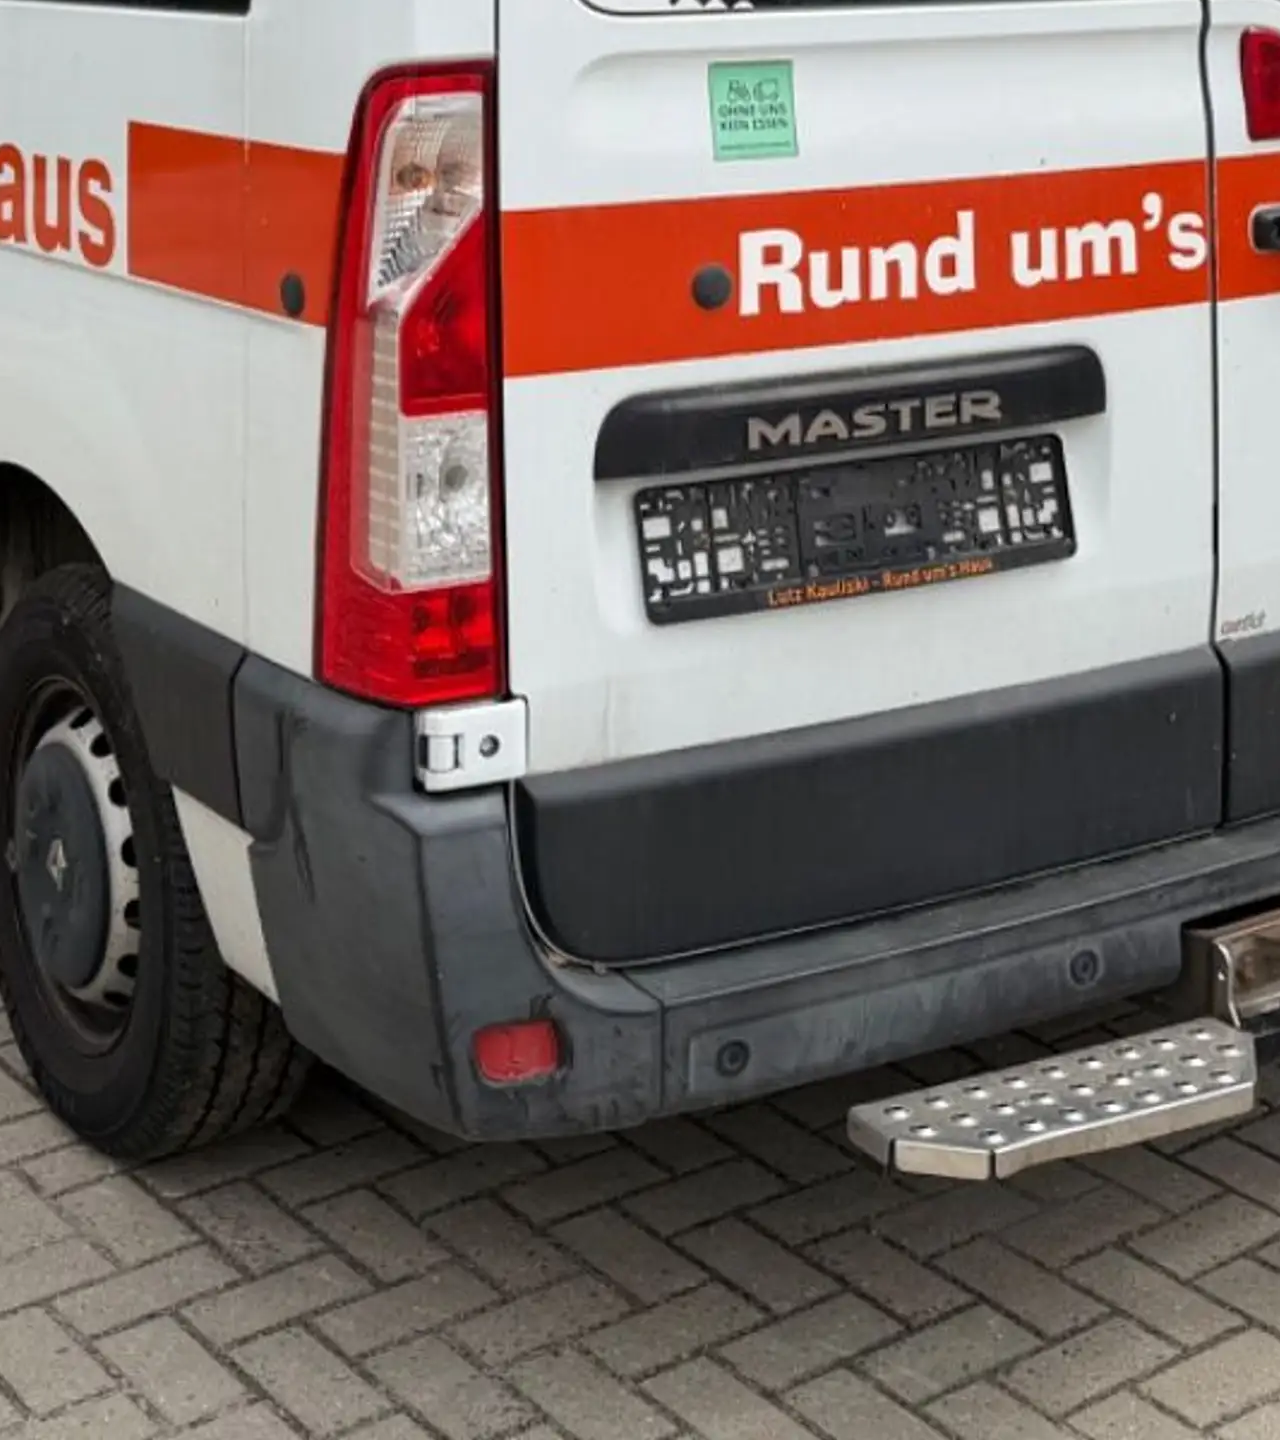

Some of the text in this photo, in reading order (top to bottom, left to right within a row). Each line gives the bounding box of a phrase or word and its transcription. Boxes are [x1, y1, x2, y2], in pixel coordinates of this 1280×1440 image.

[738, 209, 977, 317] Rund
[1010, 190, 1209, 288] um's
[747, 389, 1004, 451] MASTER
